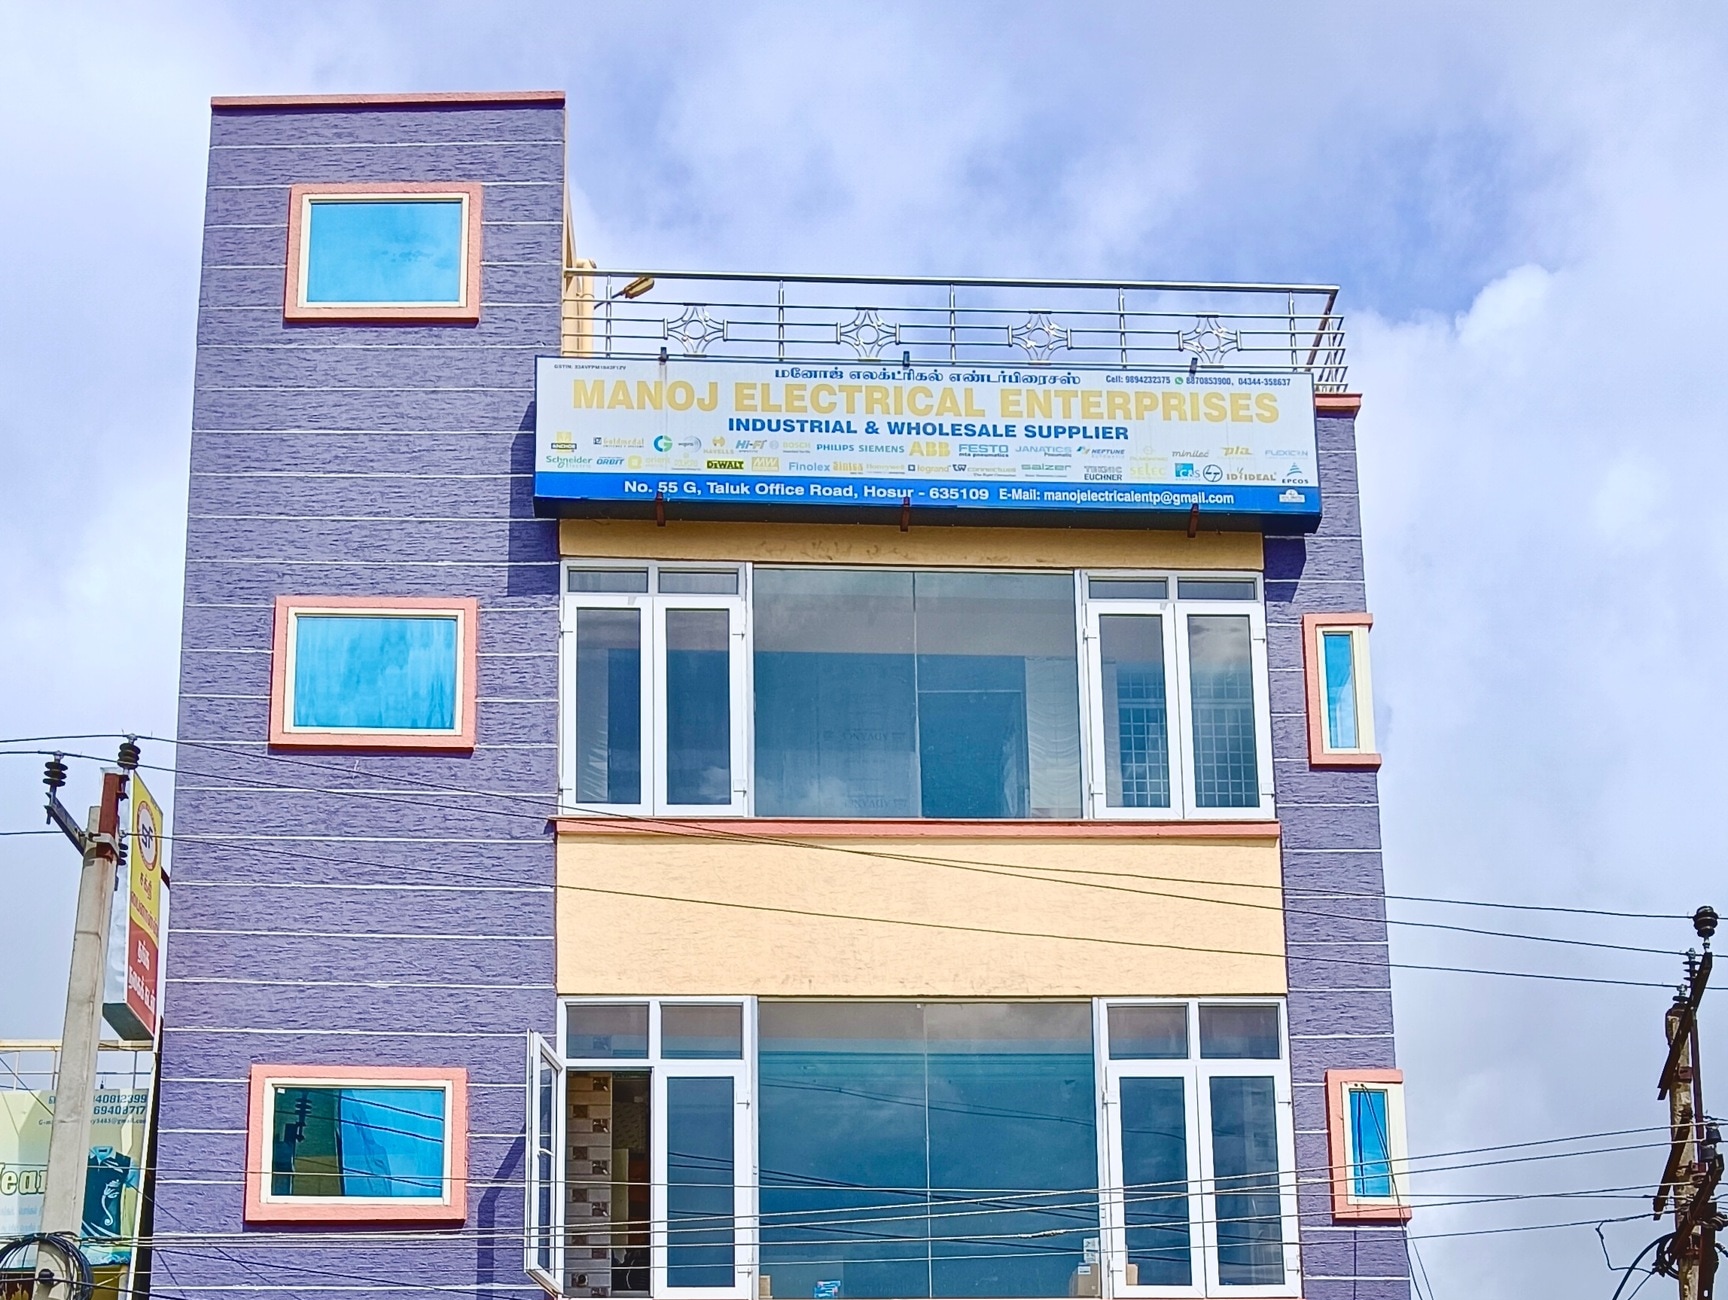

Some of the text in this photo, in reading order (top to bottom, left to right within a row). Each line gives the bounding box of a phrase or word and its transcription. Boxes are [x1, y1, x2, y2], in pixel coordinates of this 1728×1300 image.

[775, 366, 844, 380] மனோஜ்
[1106, 375, 1123, 384] Cell:
[1125, 375, 1171, 385] 9894232375
[573, 379, 1280, 424] MANOJ ELECTRICAL ENTERPRISES
[728, 418, 1129, 440] INDUSTRIAL & WHOLESALE SUPPLIER
[736, 439, 767, 450] Hi-Fi
[816, 443, 855, 452] PHILIPS
[858, 444, 905, 454] SIEMENS
[908, 441, 951, 457] ABB
[959, 443, 1009, 453] FESTO
[546, 455, 593, 466] Schneider
[596, 457, 625, 466] ORBIT
[788, 461, 830, 471] Finolex
[1084, 473, 1123, 481] EUCHNER
[624, 481, 1234, 506] No. 55 G, Taluk Office Road, Hosur 635109 E-Mail: manojelectricalentp@gmail.com
[93, 1094, 147, 1103] 40812399
